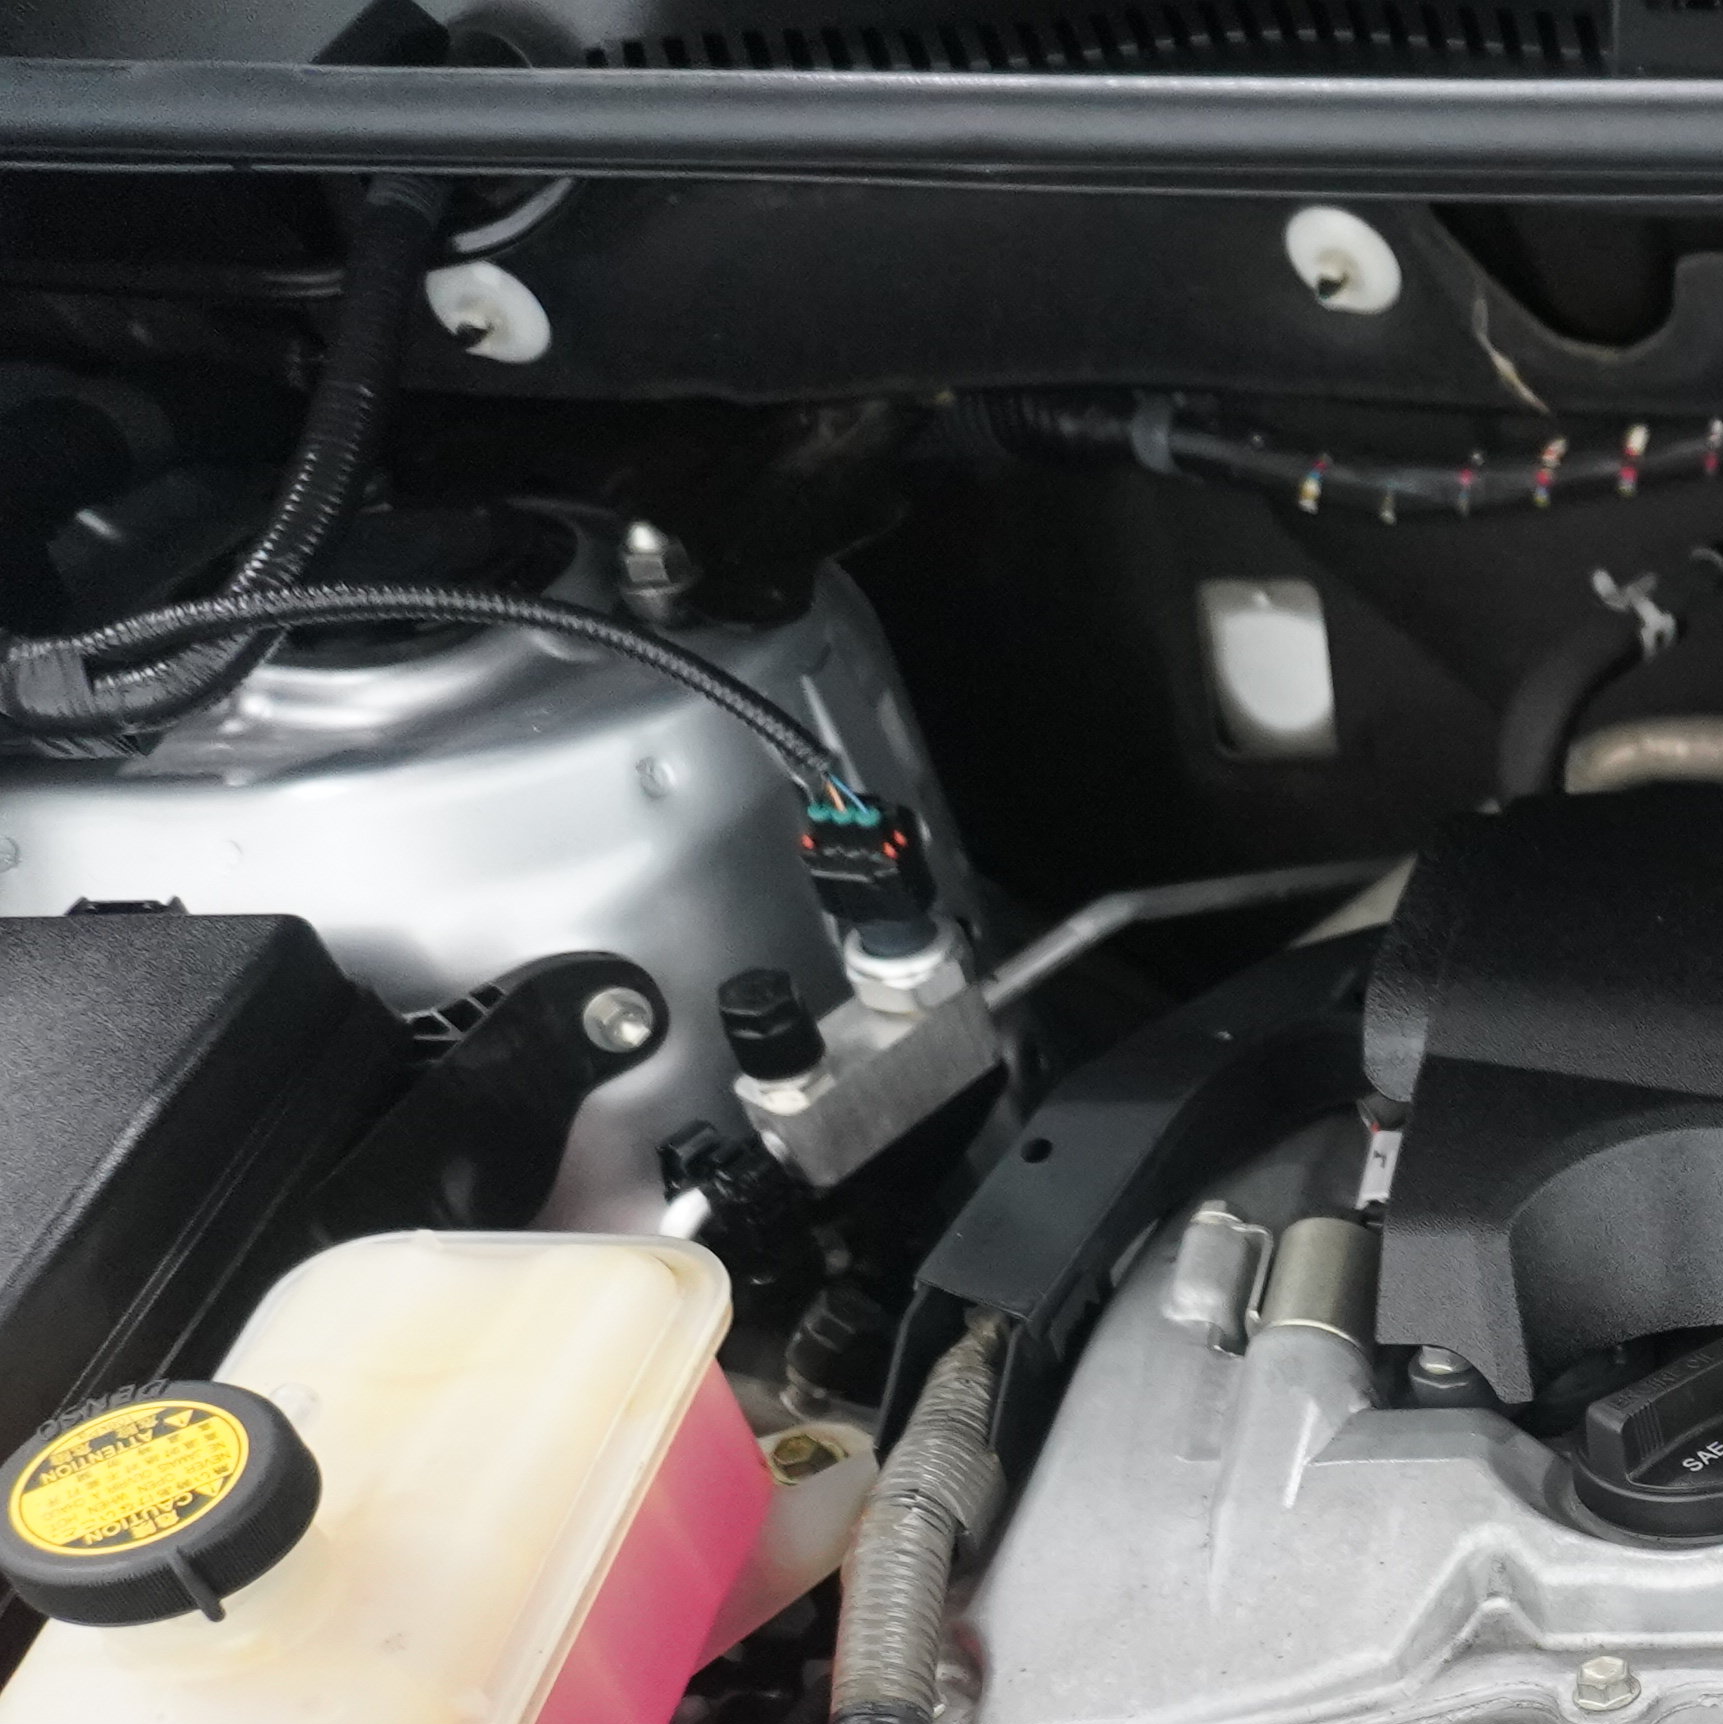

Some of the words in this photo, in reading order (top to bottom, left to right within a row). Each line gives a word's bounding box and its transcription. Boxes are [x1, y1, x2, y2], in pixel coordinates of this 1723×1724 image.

[37, 1378, 167, 1439] DENSO
[38, 1429, 155, 1484] ATTENTION
[184, 1451, 231, 1476] NEVER
[87, 1492, 128, 1514] WHEN
[137, 1473, 175, 1494] OPEN
[81, 1491, 194, 1545] CAUTION
